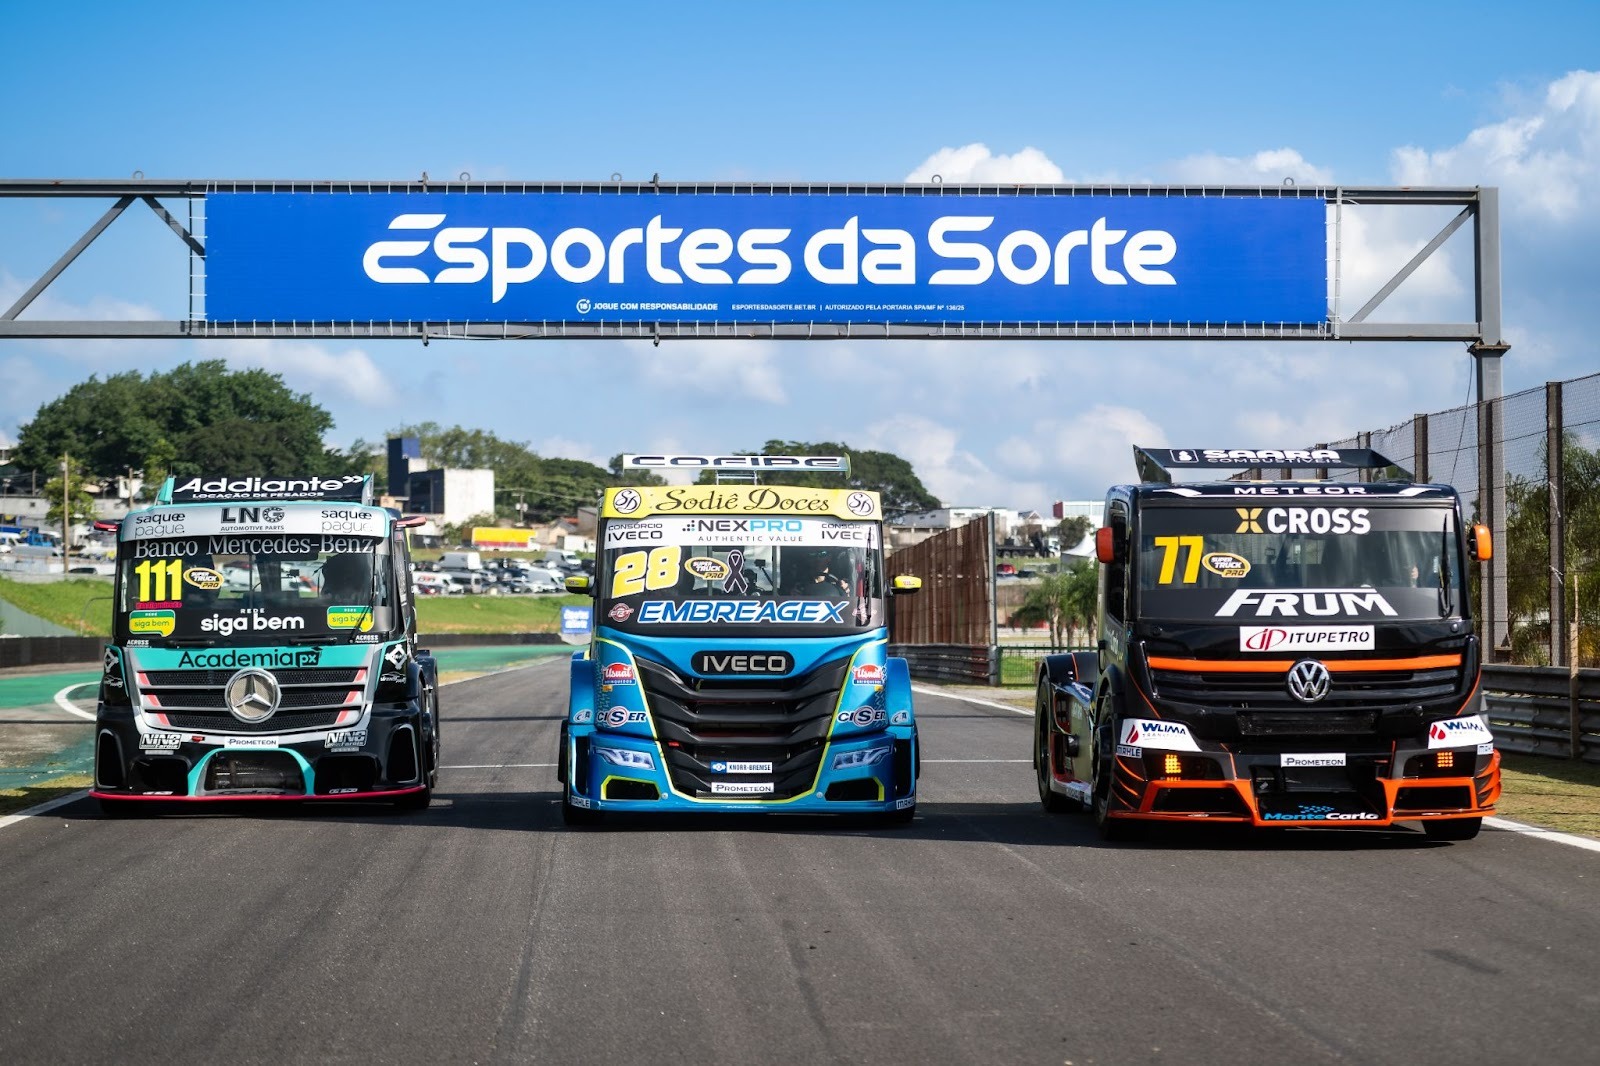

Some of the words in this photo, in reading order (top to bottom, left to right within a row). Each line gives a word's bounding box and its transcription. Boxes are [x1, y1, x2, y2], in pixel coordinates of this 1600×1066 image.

[362, 213, 792, 303] Esportes
[804, 215, 916, 285] da
[927, 215, 1177, 286] Sorte
[640, 303, 718, 311] RESPONSABILIDADE
[1202, 450, 1340, 459] SAARA
[631, 456, 840, 467] COFIPE
[174, 477, 344, 493] Addiante
[1234, 487, 1367, 495] METEOR
[655, 489, 738, 511] Sodiê
[743, 488, 829, 511] Doces
[220, 507, 285, 523] LNG
[608, 522, 663, 531] CONSÓRCIO
[698, 519, 803, 532] NEXPRO
[608, 530, 663, 542] IVECO
[134, 538, 199, 559] Banco
[206, 533, 374, 555] Mercedes-Benz
[1154, 535, 1204, 585] 77
[1214, 561, 1242, 569] TRUCK
[611, 545, 682, 599] 28
[134, 559, 182, 602] 111
[1214, 588, 1399, 617] FRUM
[637, 600, 850, 623] EMBREAGEX
[134, 619, 151, 629] siga
[151, 619, 170, 627] bem
[200, 613, 248, 636] siga
[252, 612, 305, 631] bem
[332, 616, 349, 624] siga
[1289, 631, 1370, 644] ITUPETRO
[703, 655, 786, 672] IVECO
[597, 711, 647, 723] CISER
[1284, 757, 1344, 765] PROMETEON
[714, 784, 772, 792] PROMETEON
